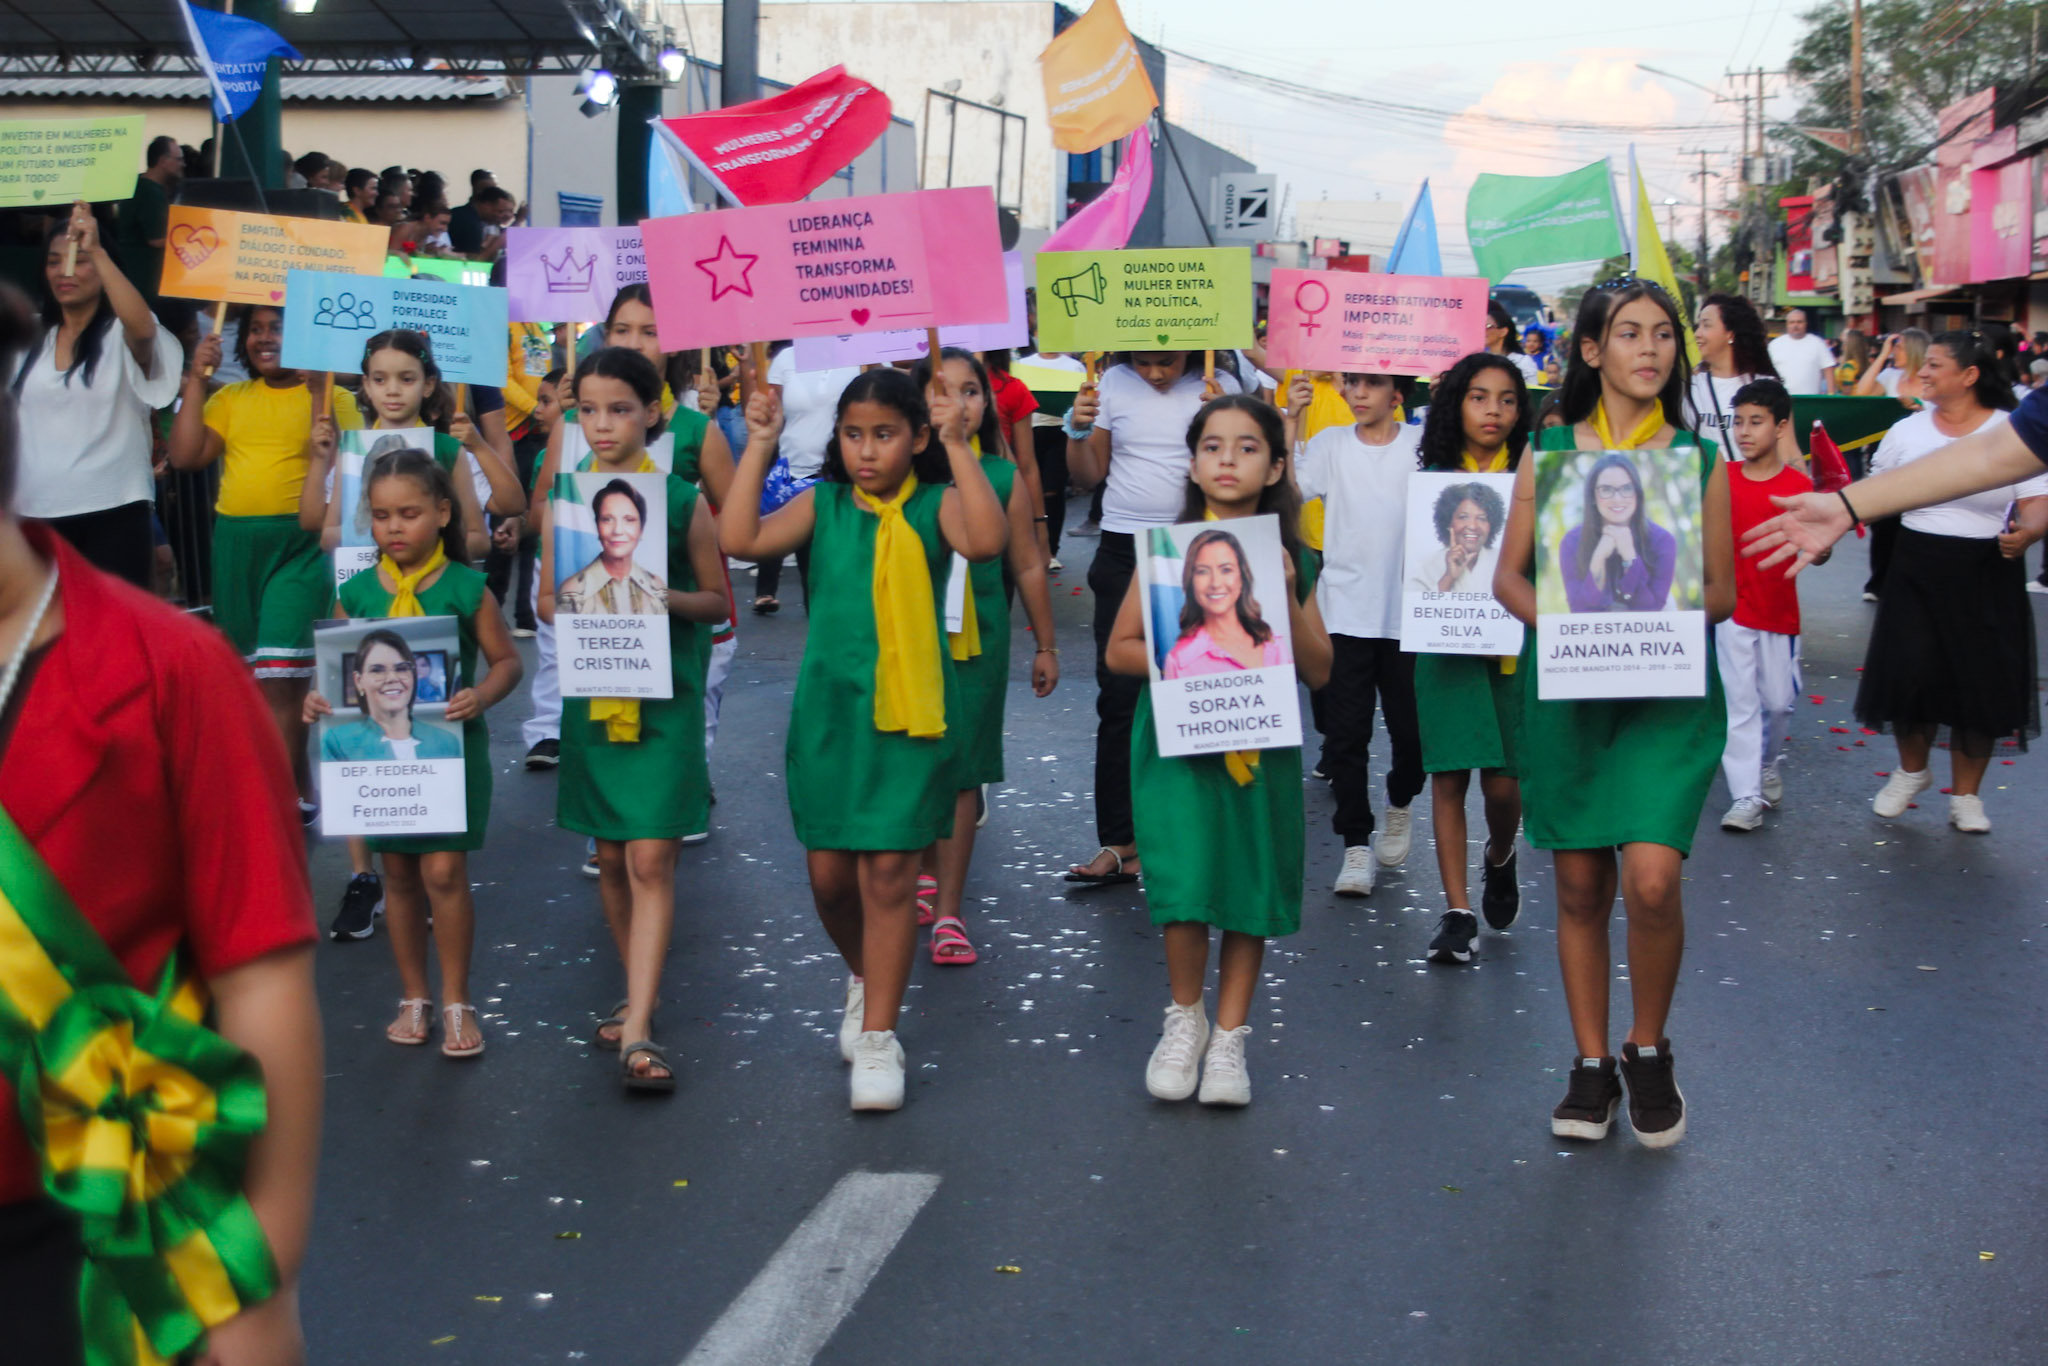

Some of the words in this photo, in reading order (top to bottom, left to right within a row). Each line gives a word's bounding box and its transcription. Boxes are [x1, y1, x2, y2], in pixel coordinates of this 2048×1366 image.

[2, 131, 43, 141] INVESTIR
[46, 130, 60, 140] EM
[62, 128, 112, 140] MULHERES
[114, 127, 128, 137] NA
[714, 130, 783, 155] MULHERES
[780, 121, 806, 137] NO
[55, 143, 97, 154] INVESTIR
[99, 142, 113, 152] EM
[713, 138, 812, 173] TRANSFORMAM
[16, 159, 55, 169] FUTURO
[58, 157, 96, 168] MELHOR
[1224, 183, 1235, 230] STUDIO
[789, 212, 874, 233] LIDERANÇA
[239, 239, 287, 254] DIÁLOGO
[288, 247, 297, 255] E
[616, 238, 644, 250] LUGA
[792, 236, 865, 257] FEMININA
[237, 256, 281, 270] MARCAS
[281, 260, 302, 270] DAS
[616, 252, 623, 266] É
[795, 257, 897, 280] TRANSFORMA
[1123, 262, 1176, 276] QUANDO
[1178, 261, 1206, 273] UMA
[234, 271, 250, 281] NA
[253, 272, 287, 284] POLÍTI
[616, 270, 649, 283] QUISE
[800, 279, 915, 303] COMUNIDADES!
[1124, 279, 1173, 291] MULHER
[1176, 279, 1215, 290] ENTRA
[393, 290, 459, 307] DIVERSIDADE
[1125, 297, 1142, 308] NA
[1146, 293, 1202, 308] POLÍTICA,
[1344, 293, 1464, 310] REPRESENTATIVIDADE
[393, 305, 449, 320] FORTALECE
[1343, 310, 1414, 326] IMPORTA!
[1115, 315, 1151, 328] todas
[1155, 312, 1219, 330] avançam!
[391, 321, 398, 330] A
[401, 321, 470, 337] DEMOCRACIA!
[1342, 330, 1364, 340] Mais
[1366, 331, 1407, 342] mulheres
[1408, 334, 1421, 343] na
[1341, 344, 1363, 353] mais
[1392, 346, 1420, 357] sendo
[337, 568, 361, 580] SIM
[1422, 591, 1449, 601] DEP.
[1451, 592, 1496, 602] FEDERA
[1413, 607, 1486, 619] BENEDITA
[1491, 608, 1511, 620] DA
[572, 619, 646, 630] SENADORA
[1440, 625, 1482, 637] SILVA
[1560, 621, 1675, 636] DEP.ESTADUAL
[578, 637, 644, 650] TEREZA
[1550, 643, 1634, 660] JANAINA
[1640, 642, 1685, 657] RIVA
[573, 657, 652, 671] CRISTINA
[1582, 665, 1621, 673] MANDATO
[1184, 674, 1264, 693] SENADORA
[1188, 694, 1265, 715] SORAYA
[1176, 714, 1283, 738] THRONICKE
[341, 766, 373, 778] DEP.
[375, 764, 438, 776] FEDERAL
[358, 783, 422, 799] Coronel
[352, 803, 428, 818] Fernanda
